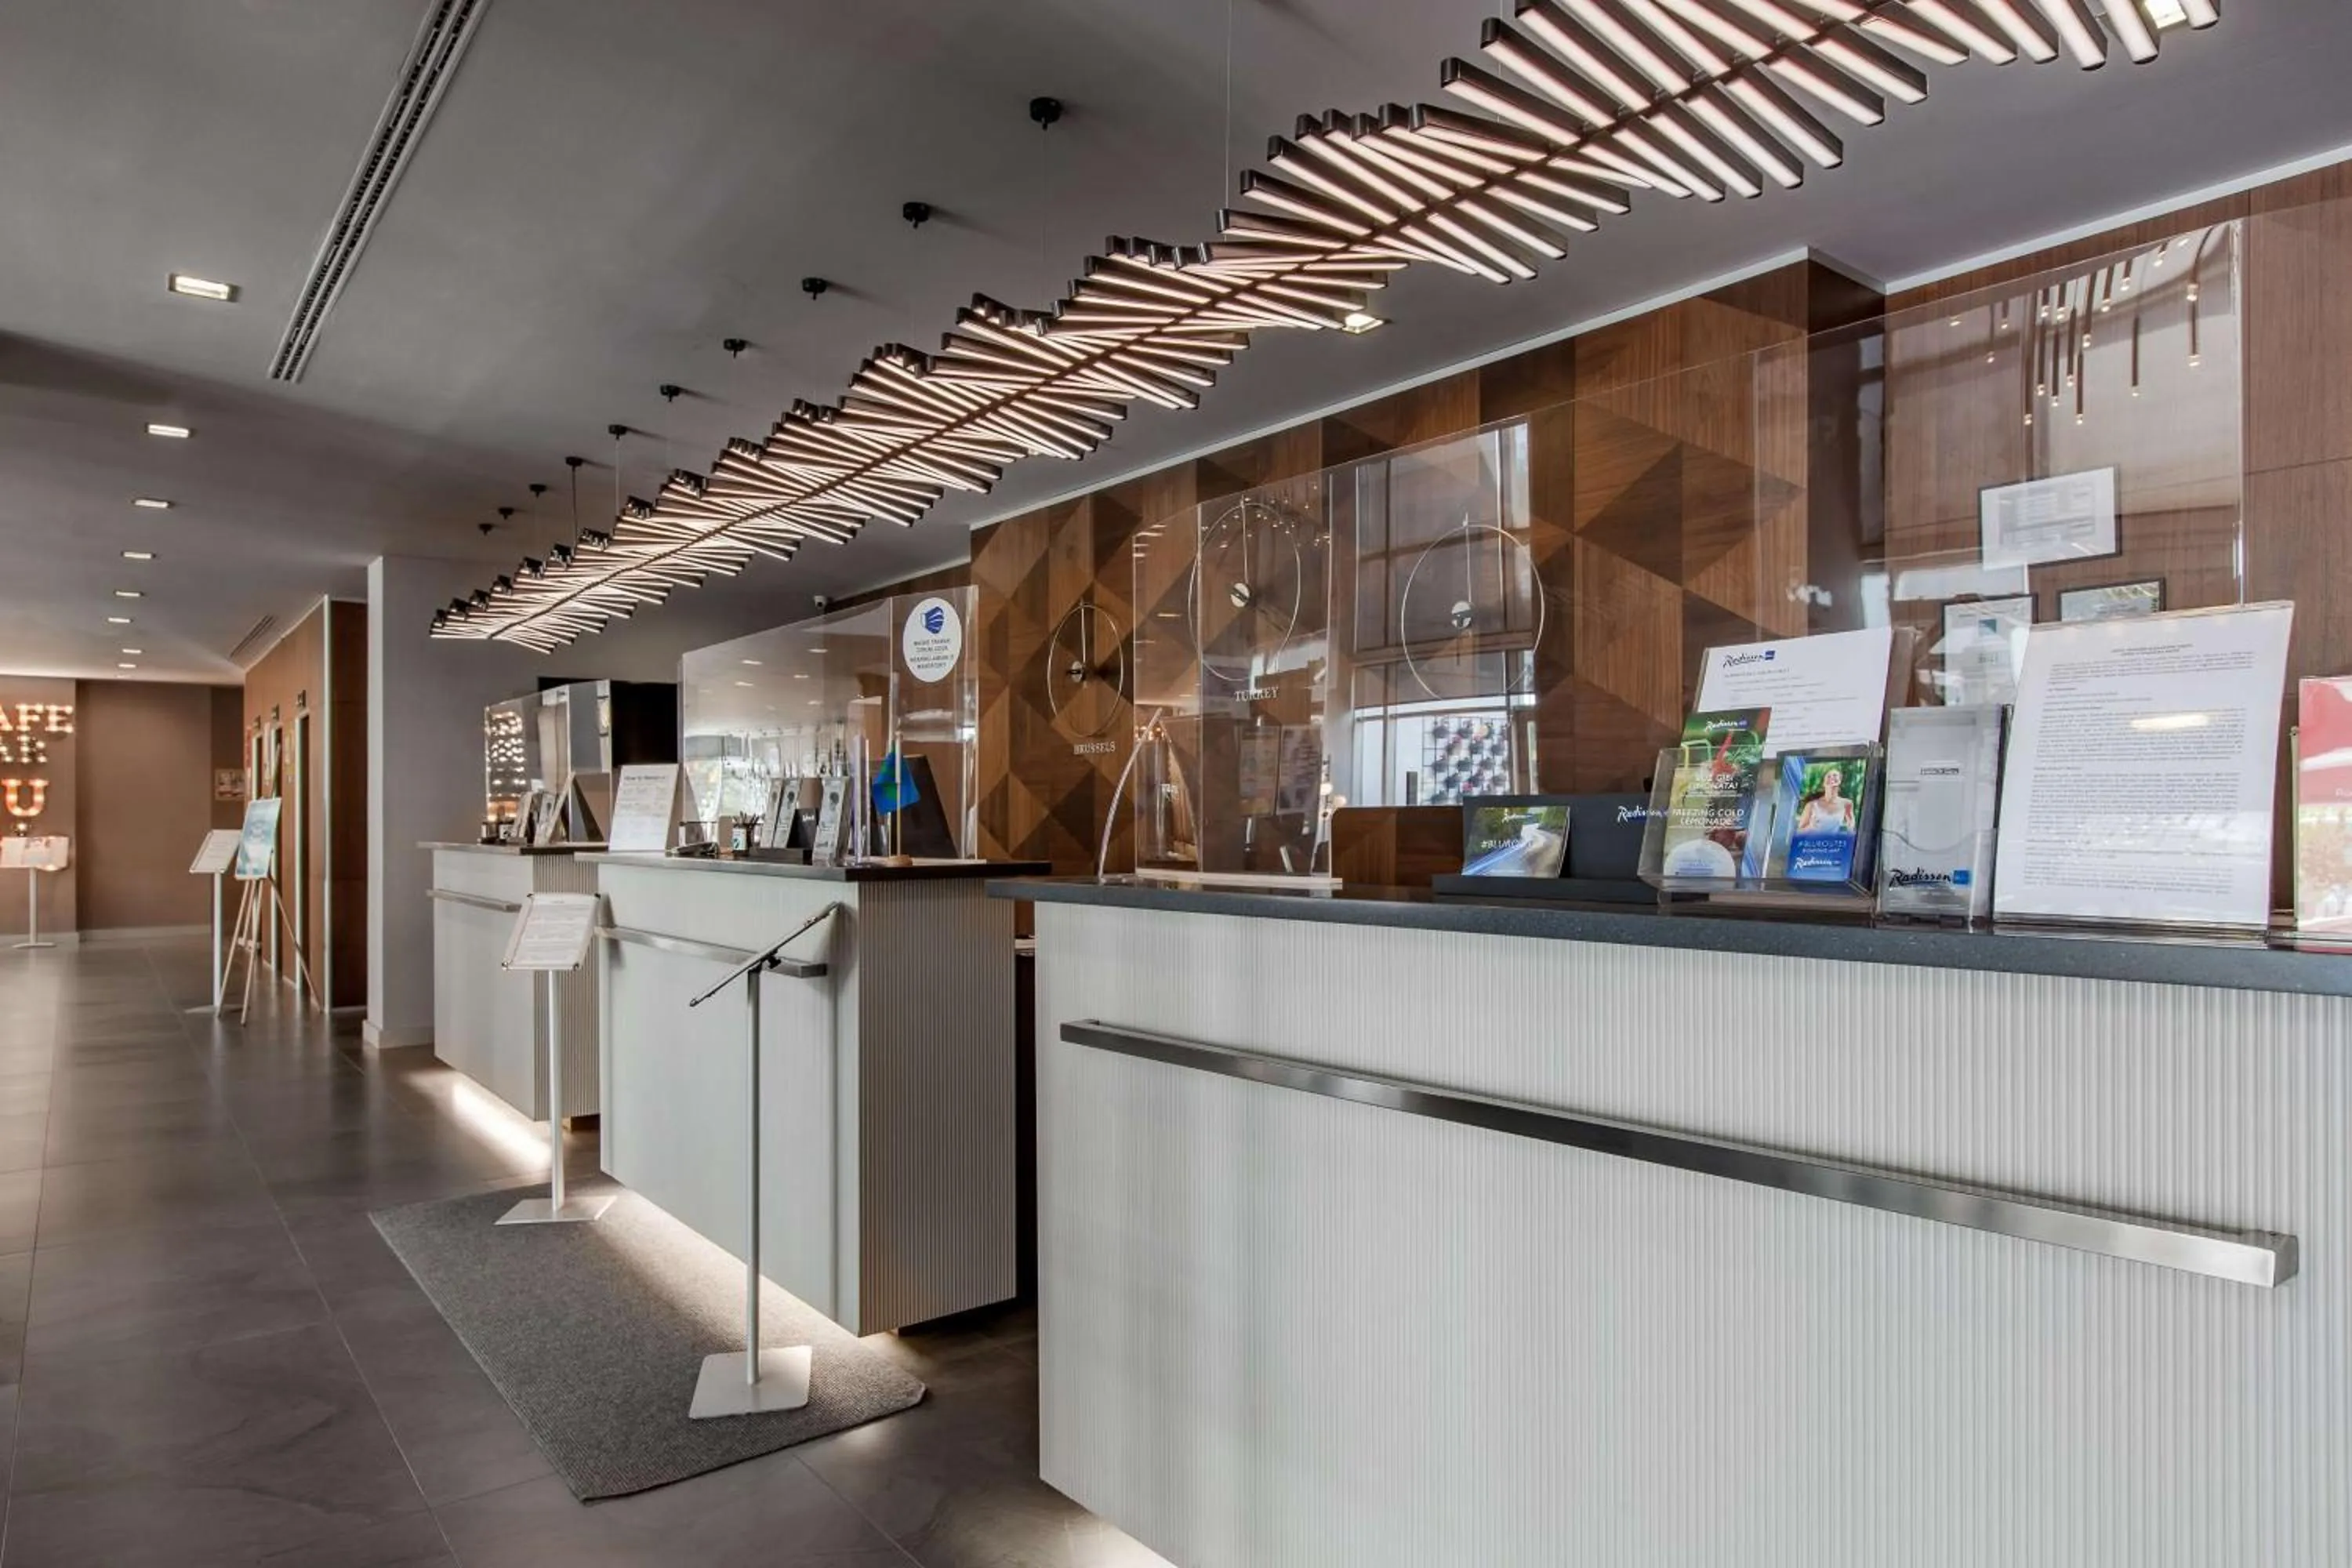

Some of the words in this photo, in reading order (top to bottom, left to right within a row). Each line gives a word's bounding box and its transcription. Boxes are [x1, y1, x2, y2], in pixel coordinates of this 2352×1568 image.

[1235, 686, 1279, 702] TURKEY
[1073, 740, 1116, 755] BRUSSELS
[1889, 866, 1951, 887] Radisson
